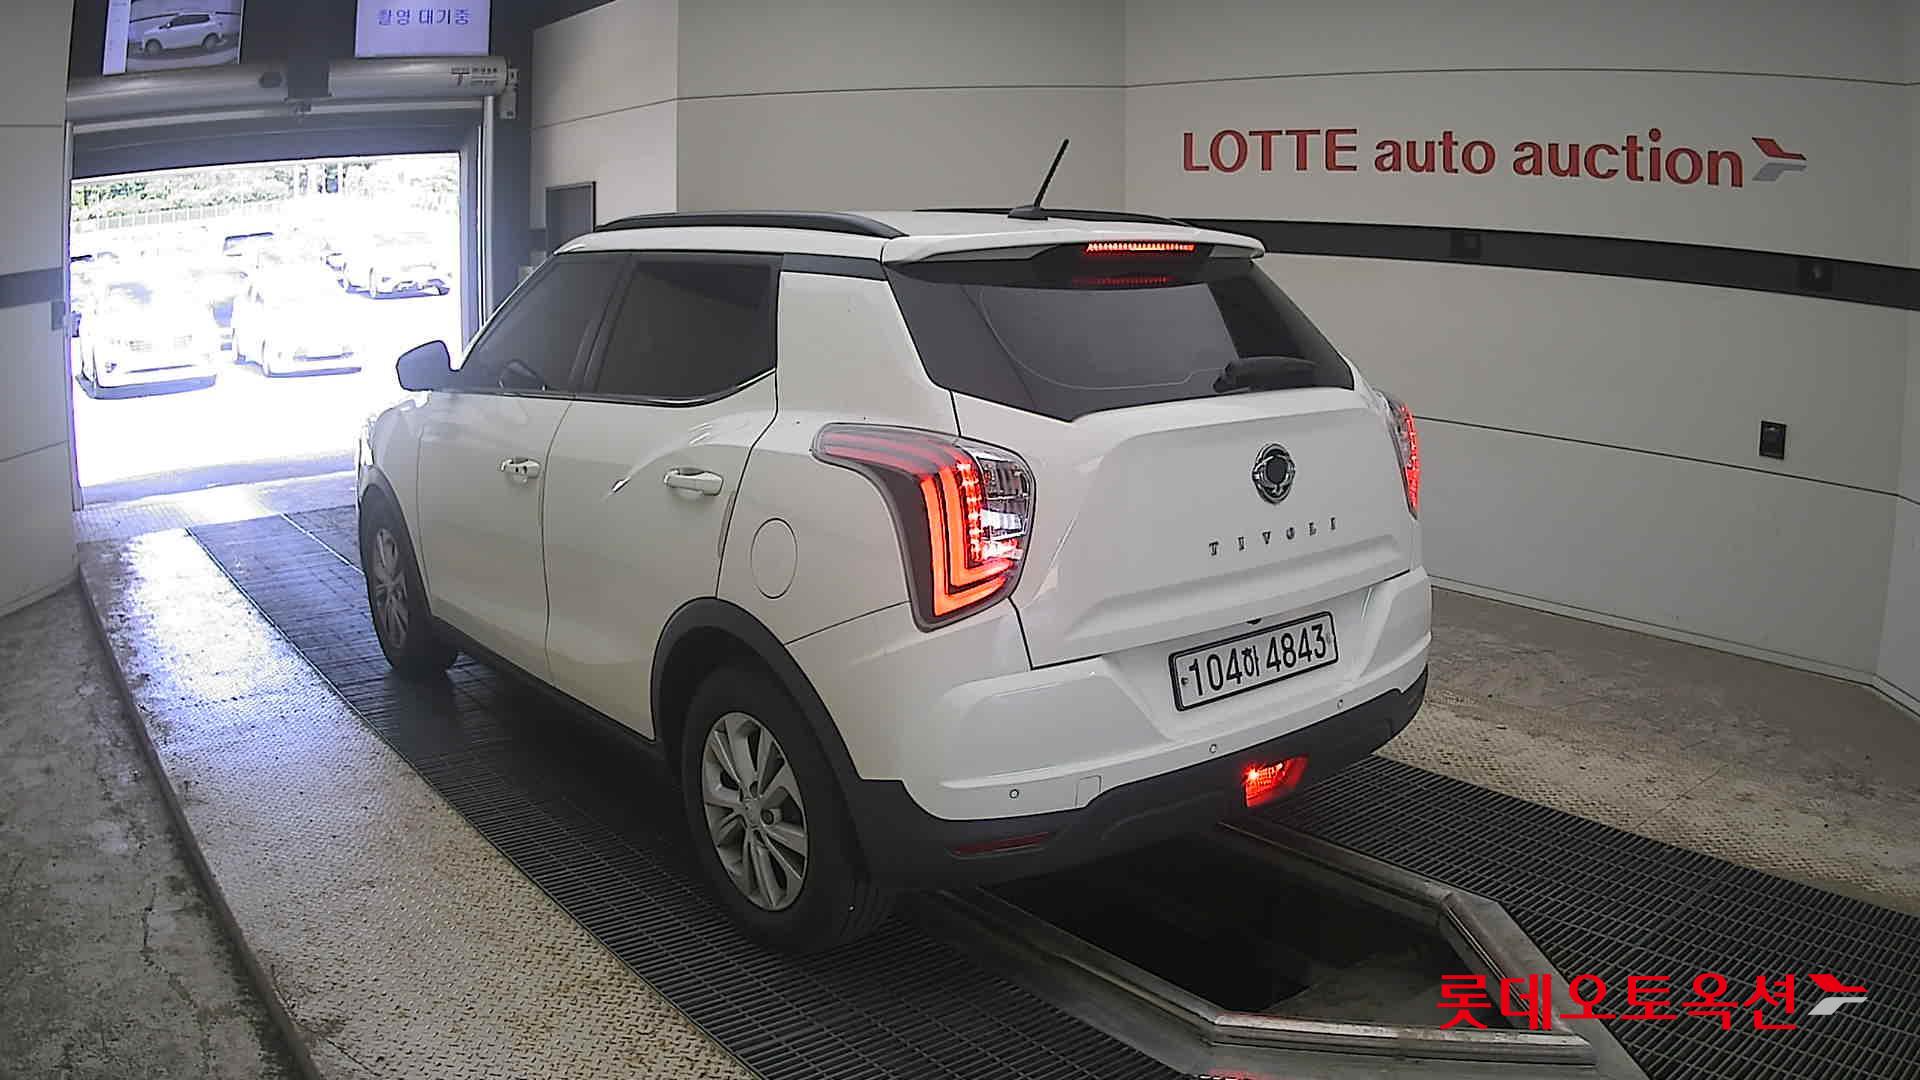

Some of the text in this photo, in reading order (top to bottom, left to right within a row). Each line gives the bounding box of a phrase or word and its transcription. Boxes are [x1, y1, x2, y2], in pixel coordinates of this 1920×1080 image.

[419, 8, 469, 26] 대기중
[1183, 128, 1744, 188] LOTTE auto auction
[1208, 517, 1336, 556] TIVOLI
[1266, 623, 1327, 673] 4843
